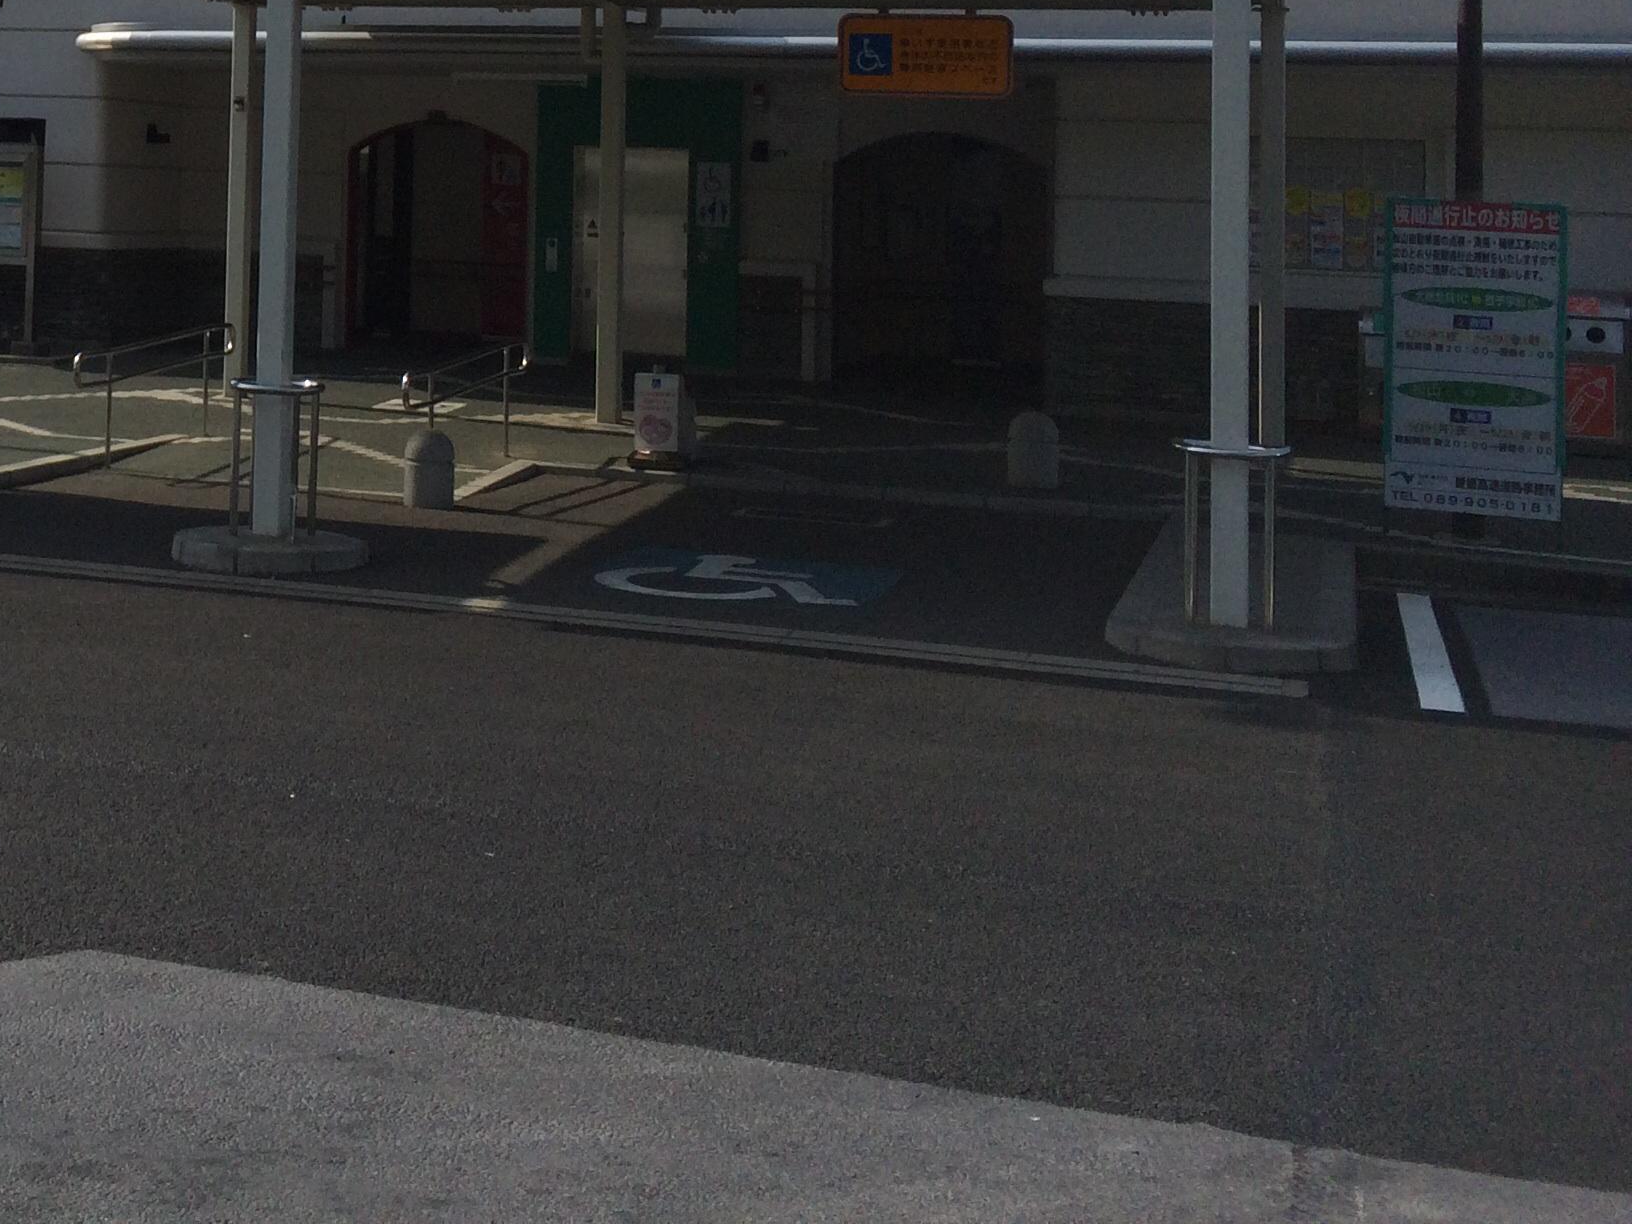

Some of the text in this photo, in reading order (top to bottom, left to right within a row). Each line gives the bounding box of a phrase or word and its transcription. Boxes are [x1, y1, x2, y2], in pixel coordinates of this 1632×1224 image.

[1393, 203, 1560, 231] 夜間通行止のお知らせ
[1392, 490, 1418, 503] TEL
